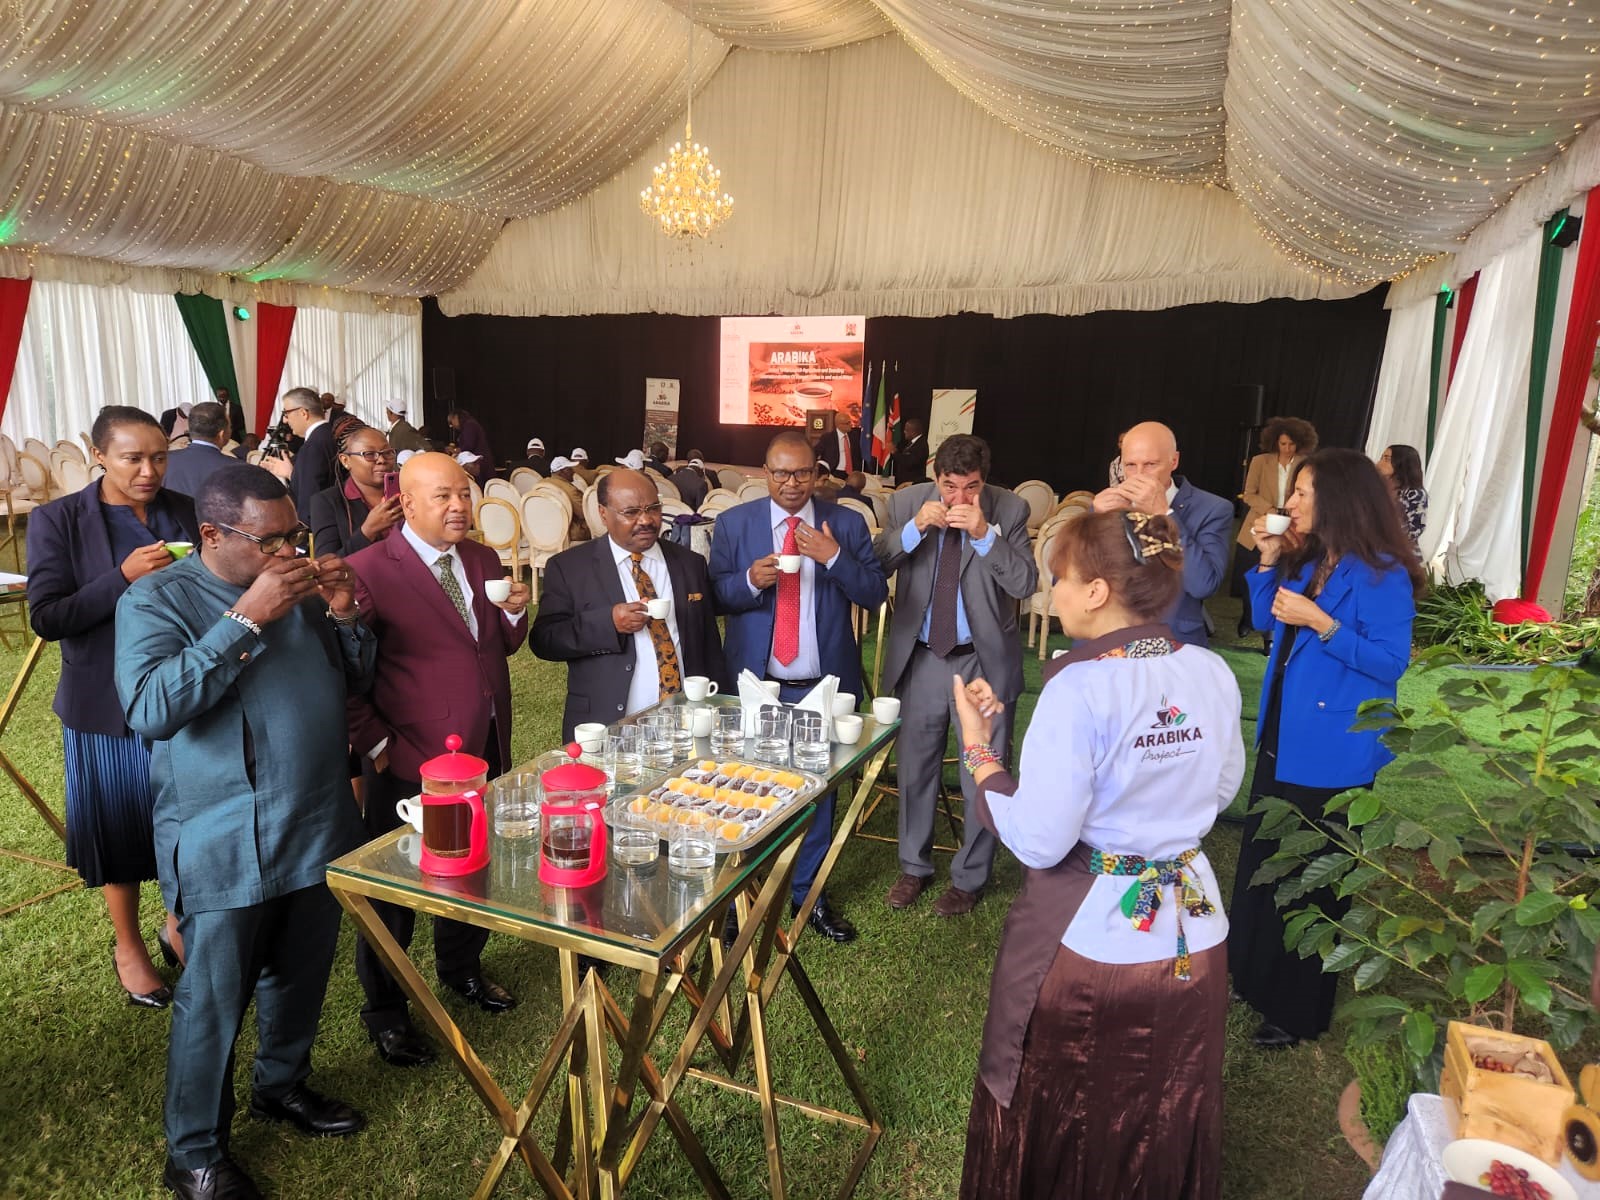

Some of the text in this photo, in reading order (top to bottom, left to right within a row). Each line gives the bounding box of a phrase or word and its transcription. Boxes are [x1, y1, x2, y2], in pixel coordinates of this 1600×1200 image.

[770, 351, 816, 364] ARABIKA
[1134, 727, 1203, 748] ARABIKA
[1141, 747, 1196, 764] Project
